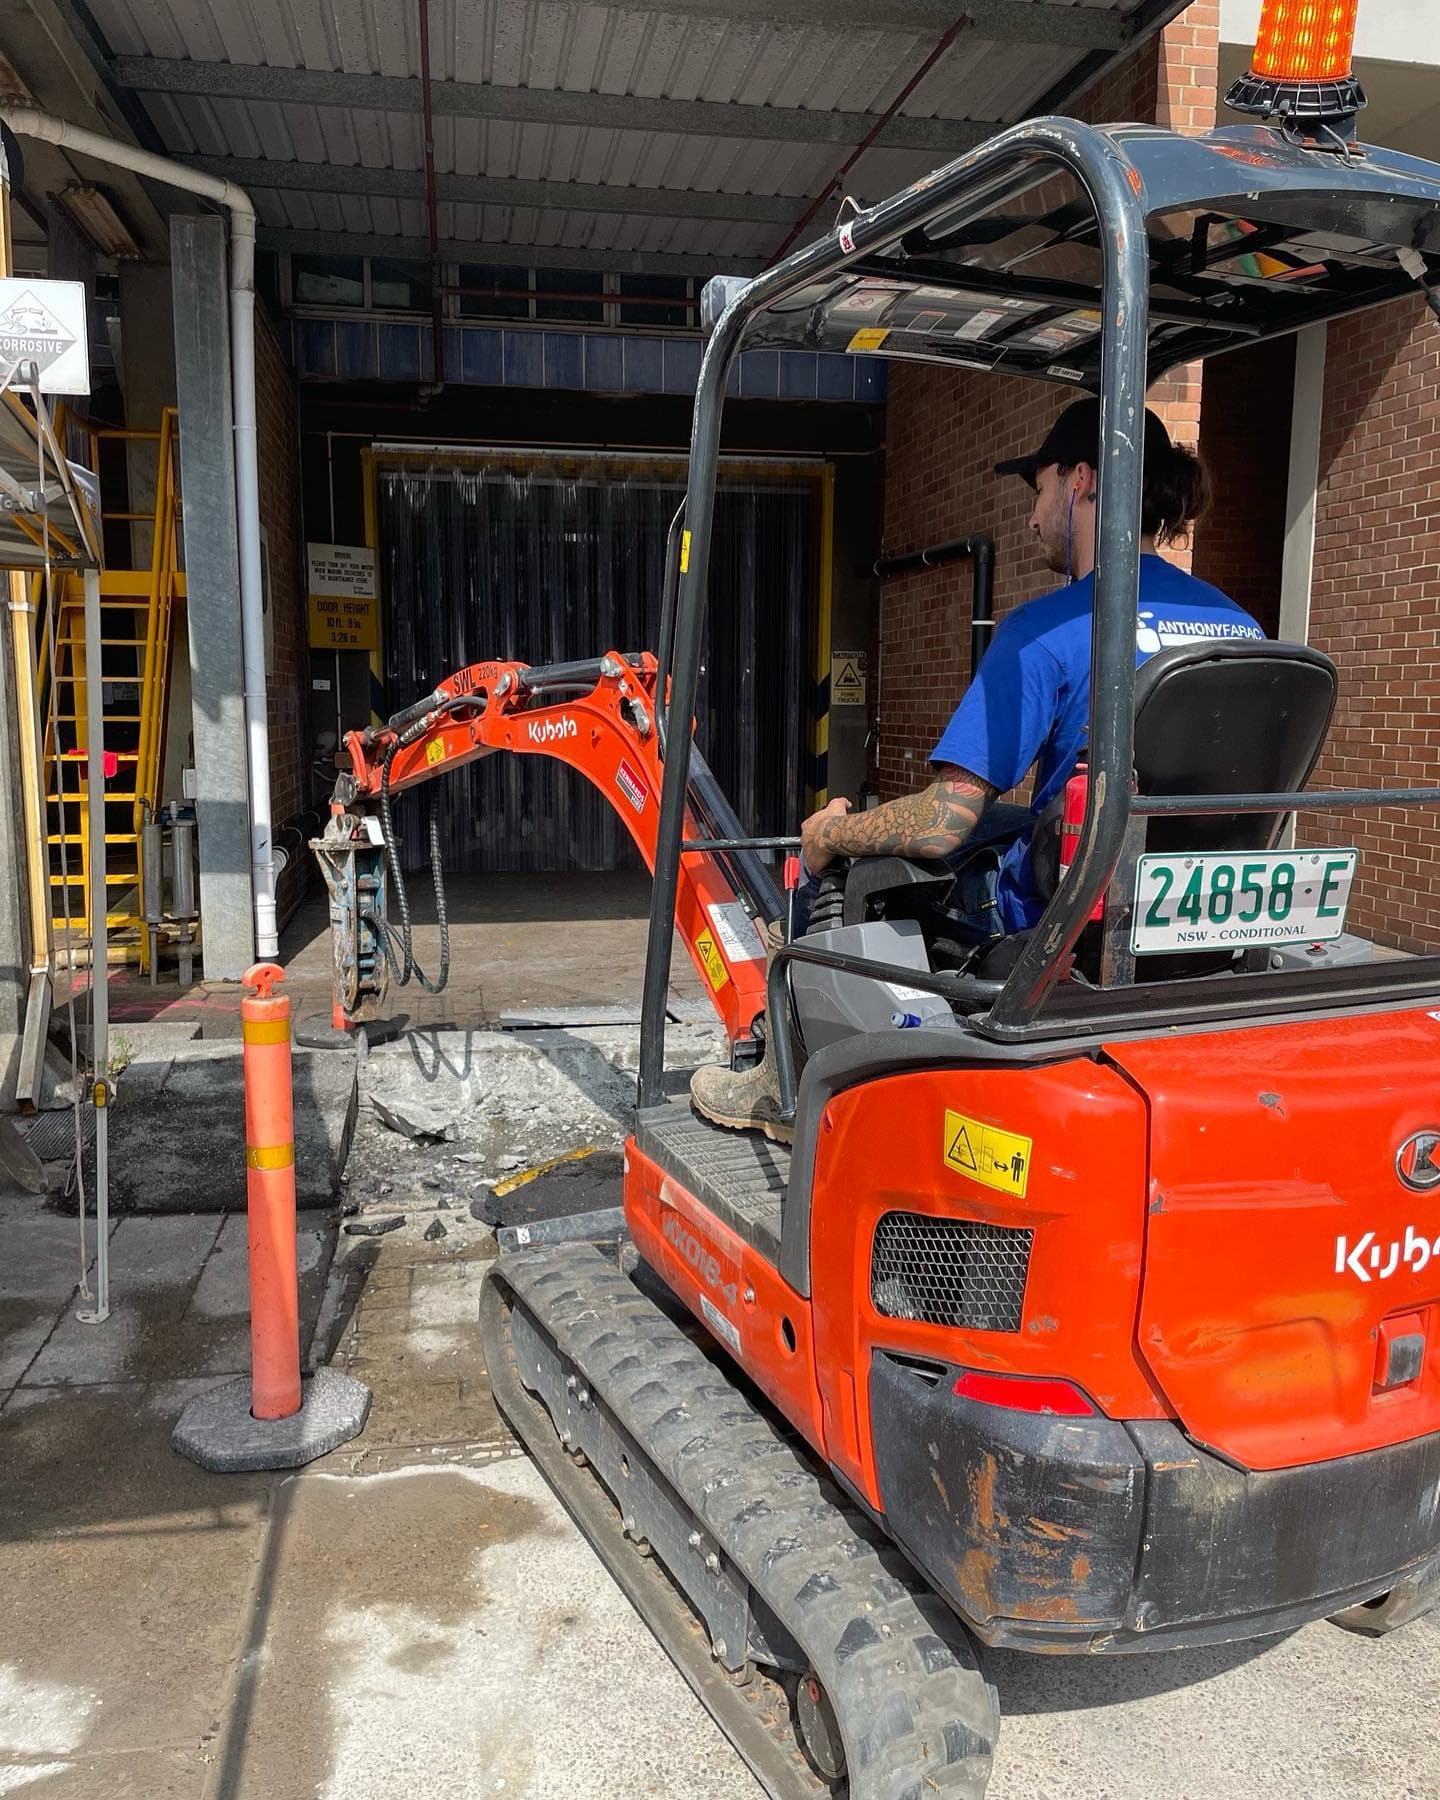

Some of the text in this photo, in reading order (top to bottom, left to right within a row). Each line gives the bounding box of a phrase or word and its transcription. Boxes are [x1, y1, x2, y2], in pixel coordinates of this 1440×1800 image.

[317, 600, 370, 615] DOOR HEIGHT
[453, 665, 498, 695] SWL 220kg
[528, 715, 577, 743] Kubota
[619, 767, 645, 804] KENNARDS
[1145, 860, 1349, 928] 24858 E
[1177, 932, 1208, 943] NSW
[1219, 925, 1307, 940] CONDITIONAL
[1335, 1225, 1440, 1282] Kub
